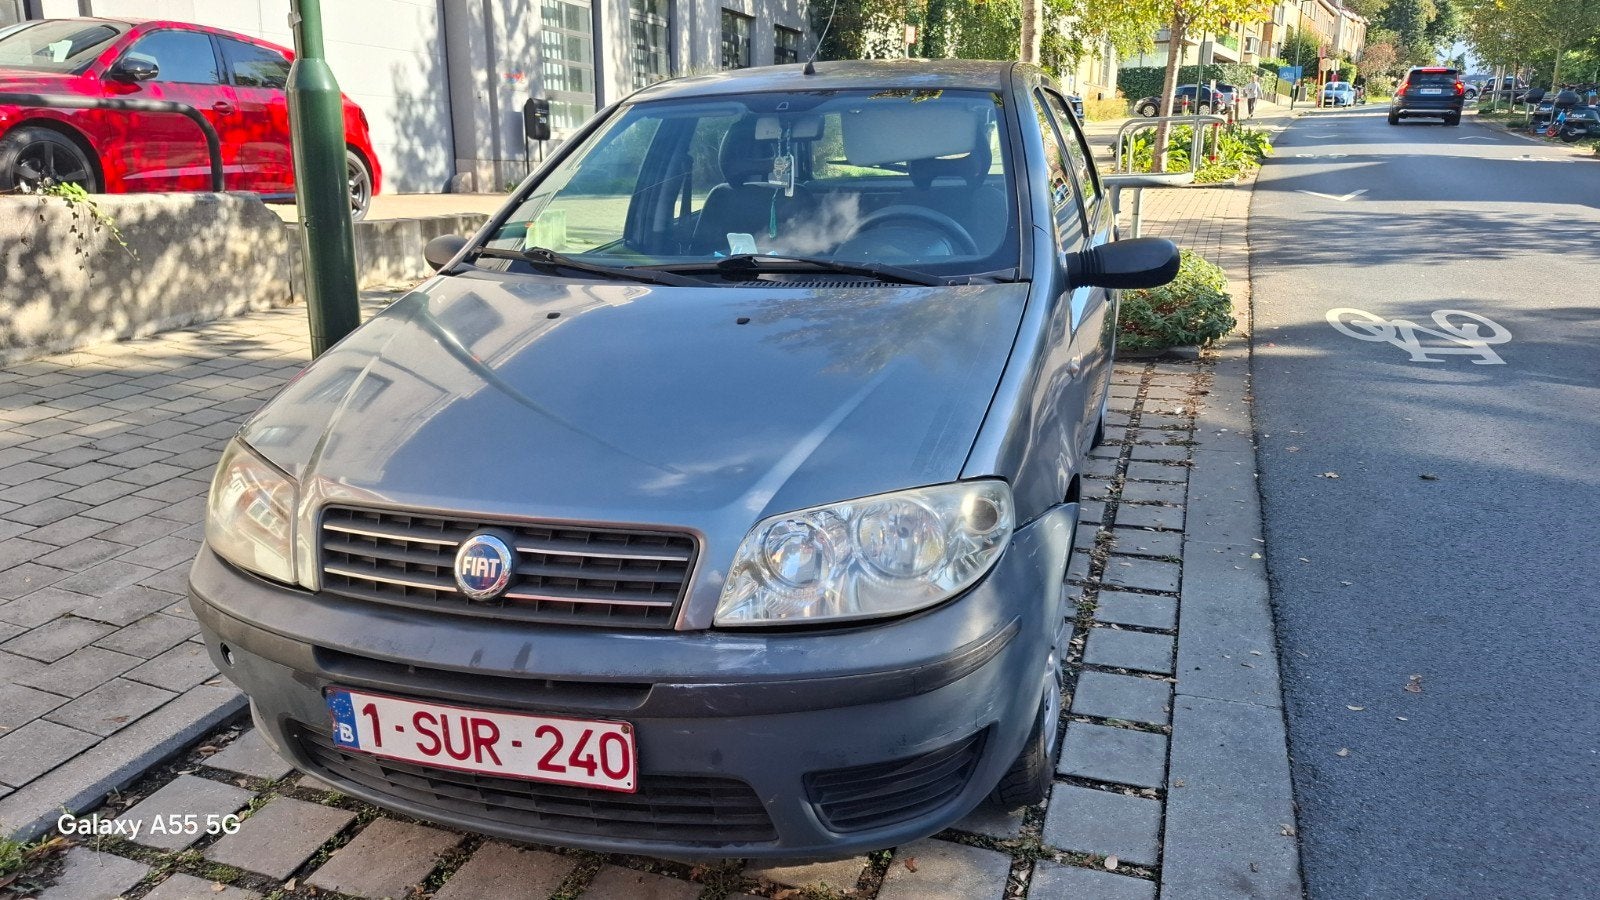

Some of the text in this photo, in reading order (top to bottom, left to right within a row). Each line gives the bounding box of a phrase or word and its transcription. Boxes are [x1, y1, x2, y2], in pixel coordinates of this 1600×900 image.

[462, 556, 500, 578] FIAT
[339, 722, 354, 742] B
[362, 703, 630, 780] 1-SUR-240
